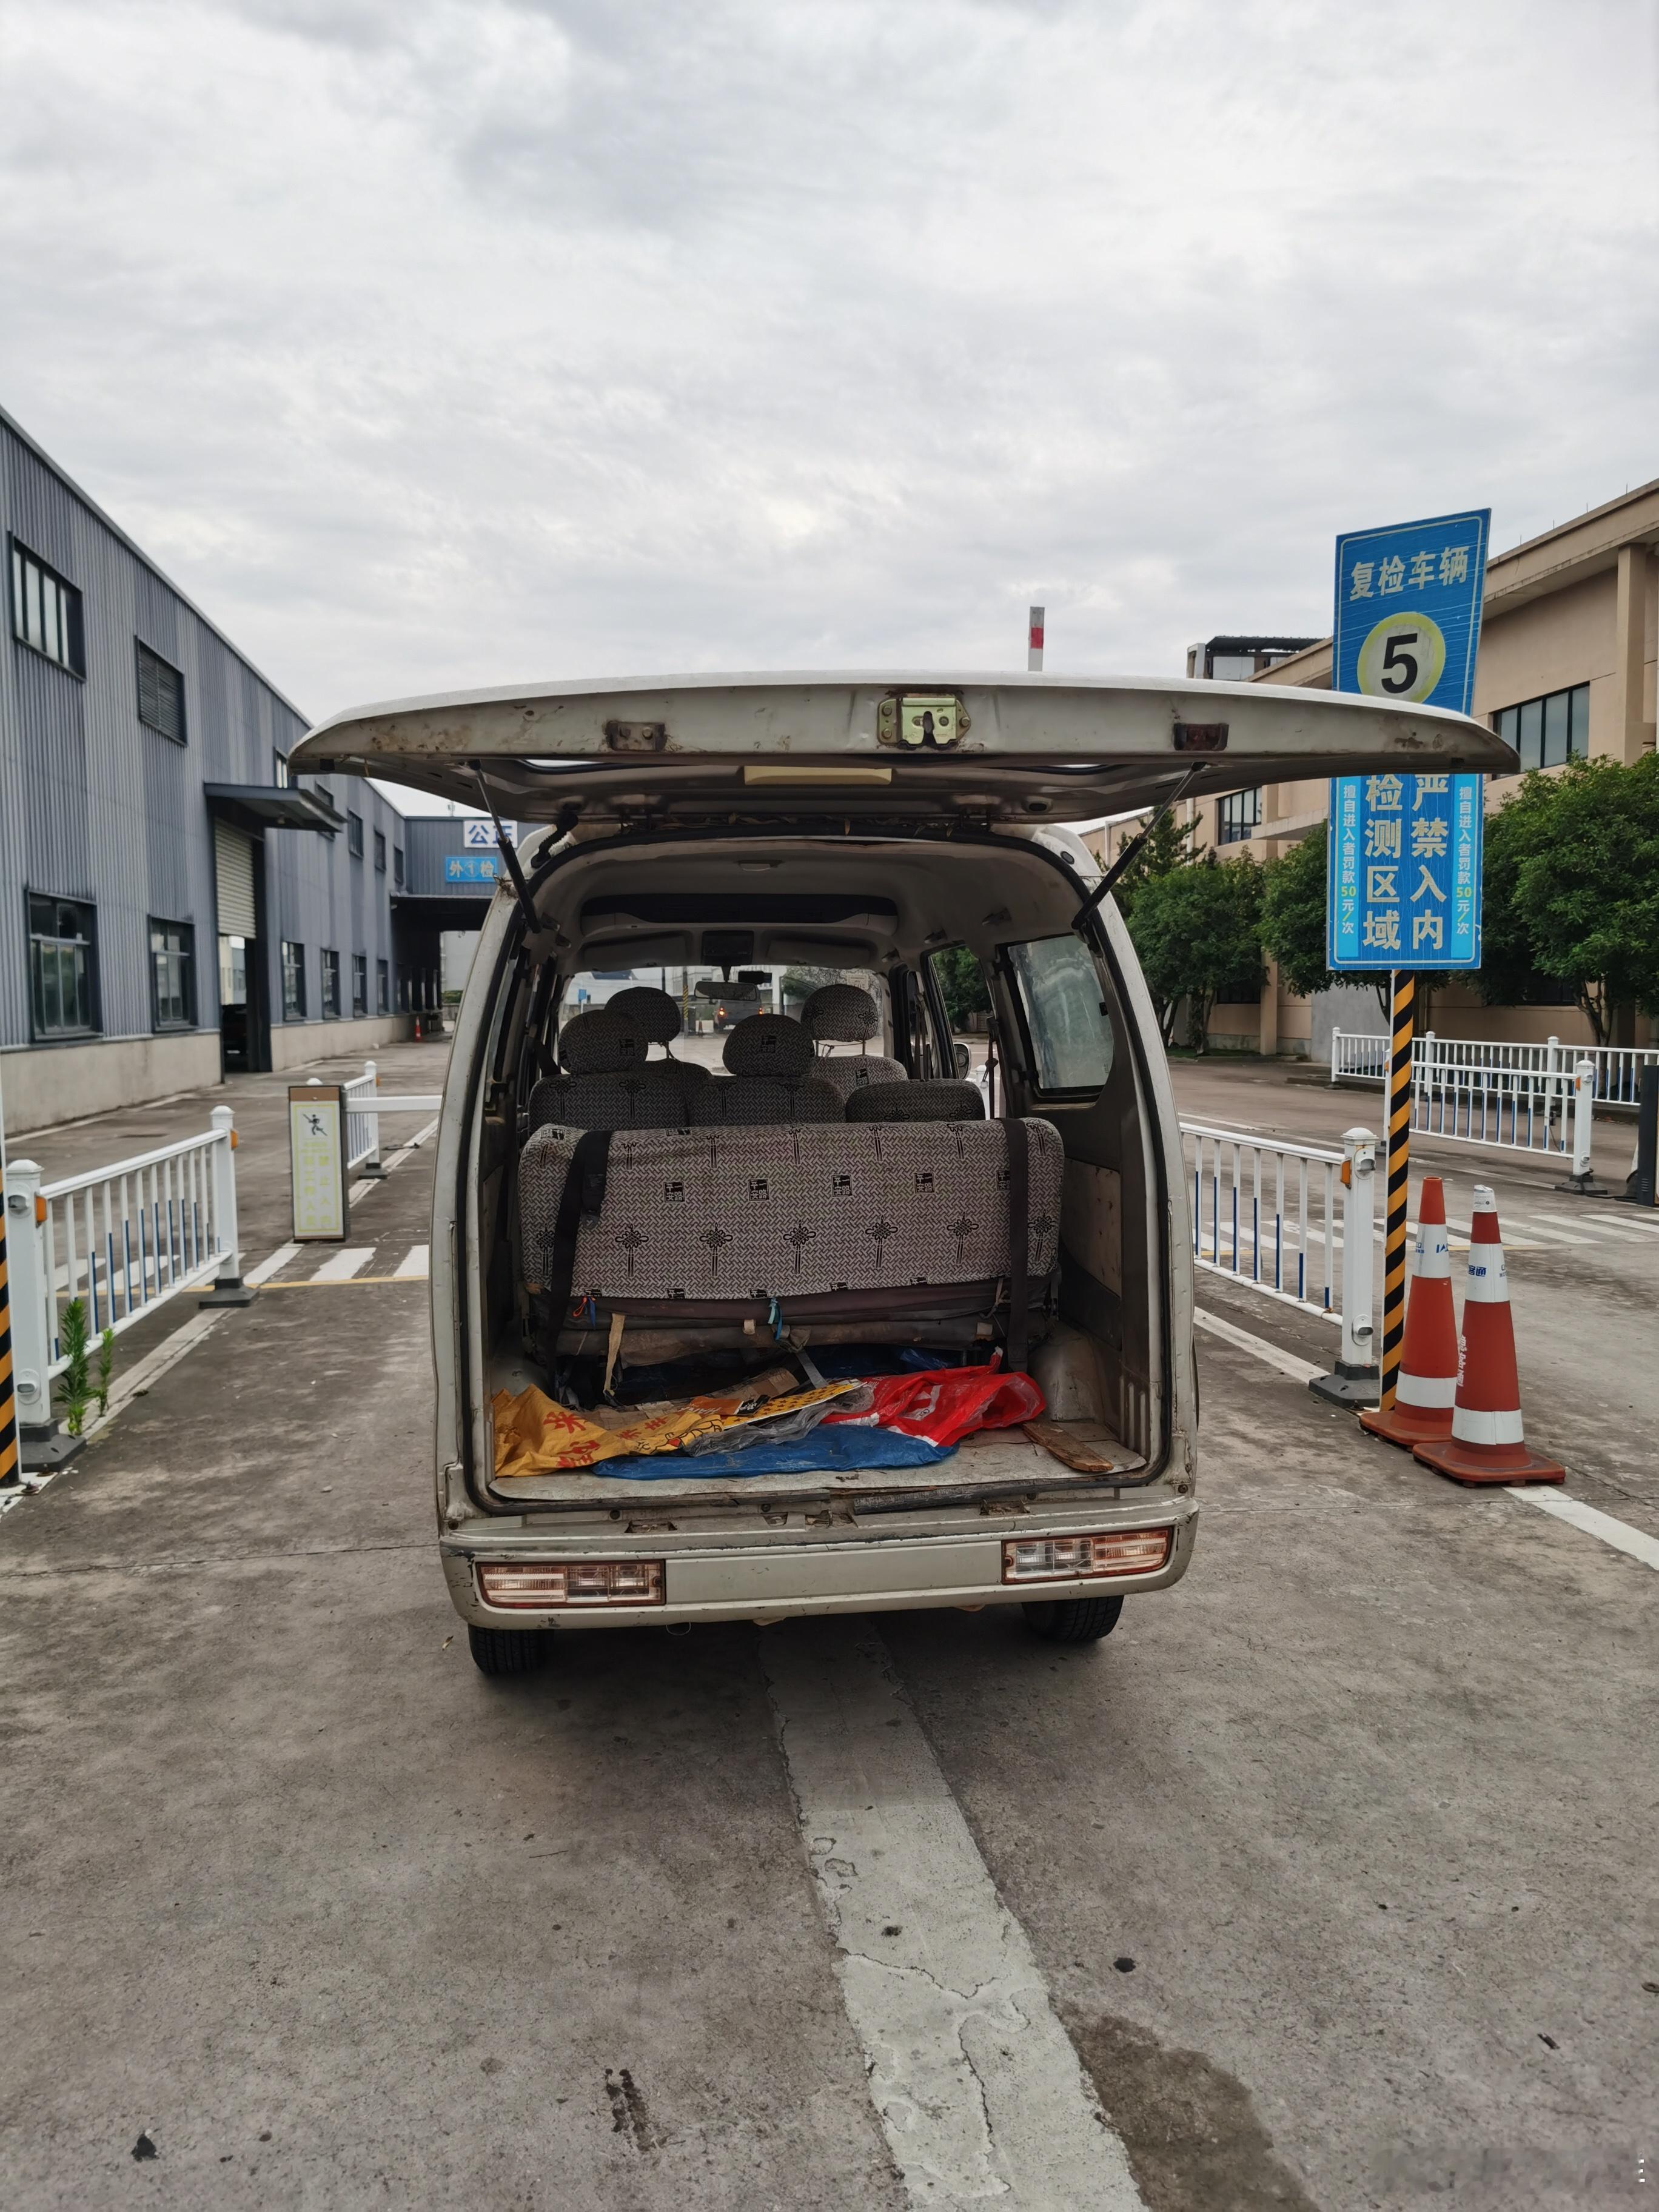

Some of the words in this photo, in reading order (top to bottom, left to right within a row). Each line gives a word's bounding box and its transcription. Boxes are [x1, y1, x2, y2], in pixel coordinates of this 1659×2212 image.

[1349, 546, 1469, 602] 复检车辆
[1381, 632, 1418, 694] 5
